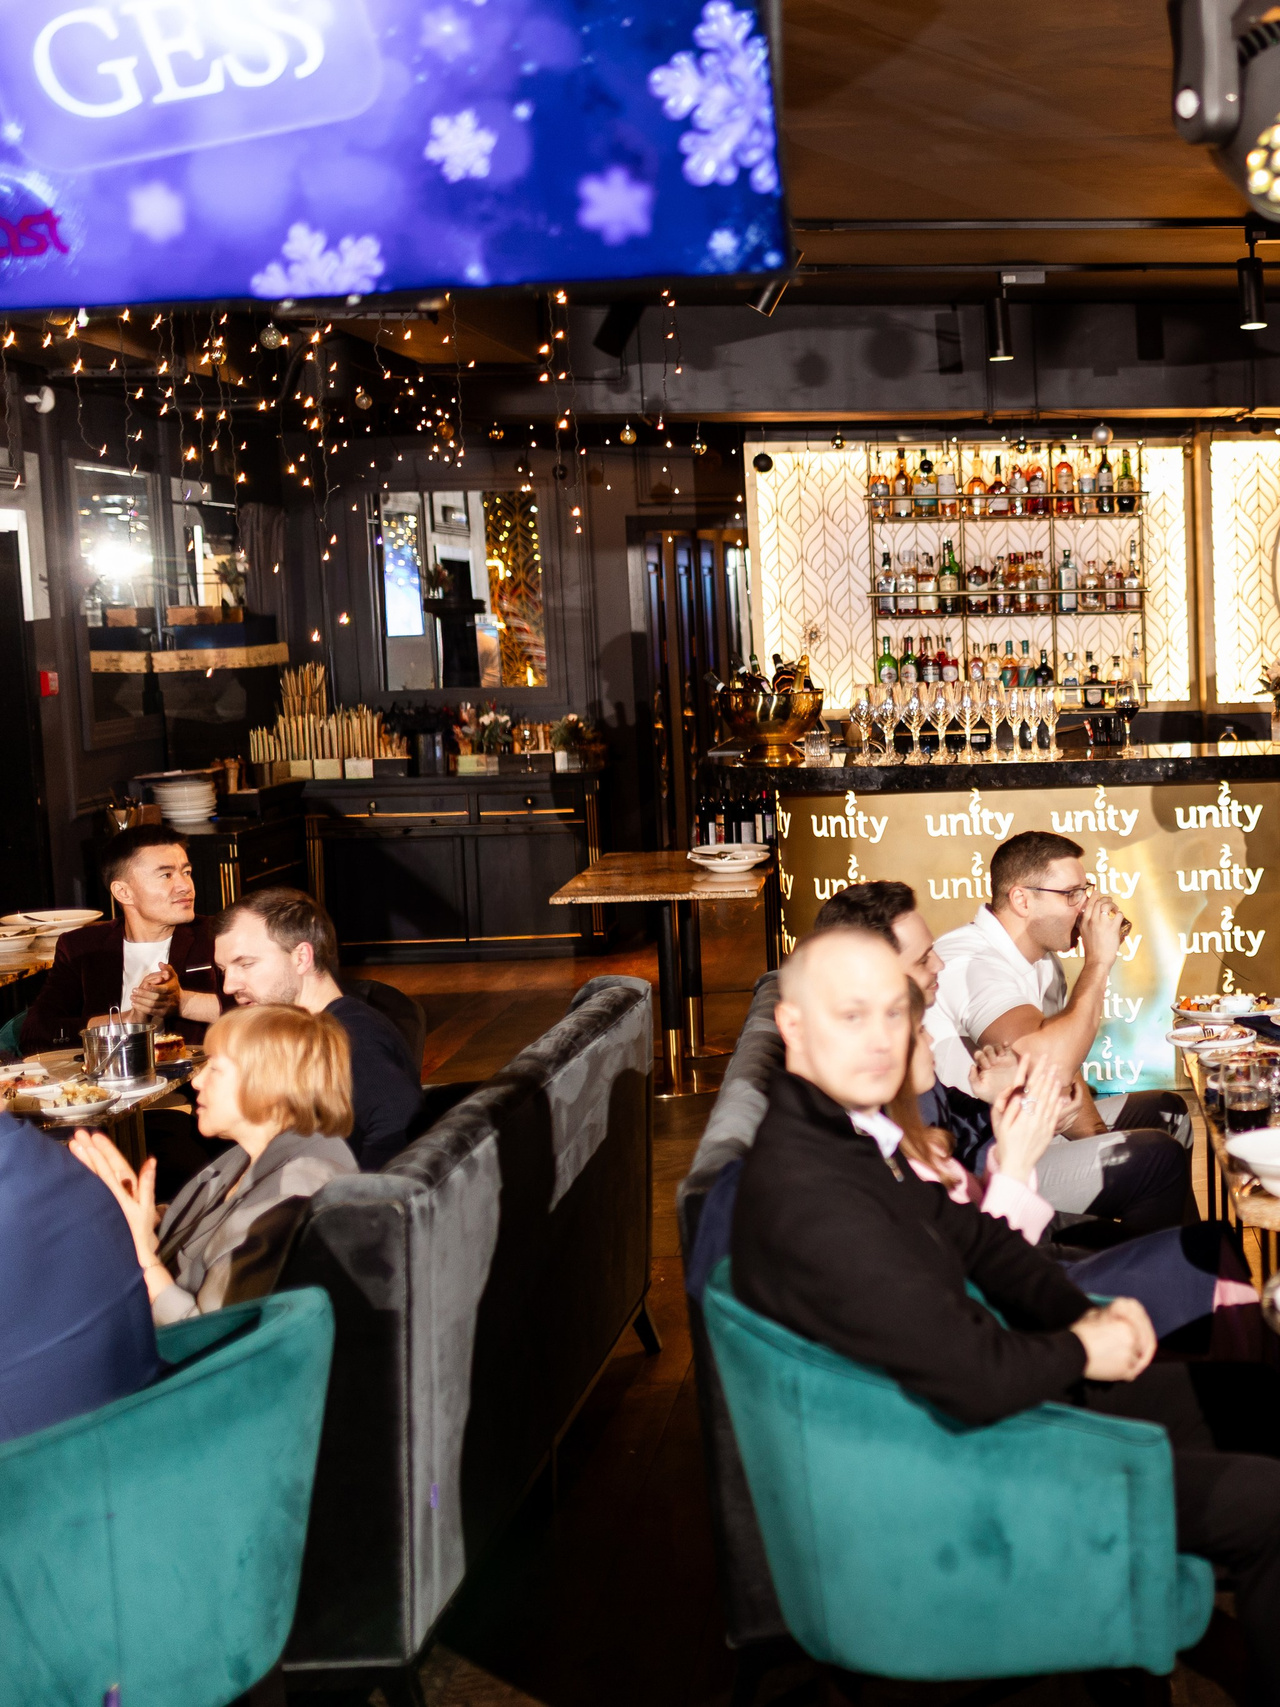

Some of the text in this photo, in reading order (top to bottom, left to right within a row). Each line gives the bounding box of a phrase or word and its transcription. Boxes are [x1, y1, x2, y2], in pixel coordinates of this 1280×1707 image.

[811, 790, 889, 844] unity
[925, 787, 1015, 841] unity
[1050, 784, 1140, 837] unity
[1174, 780, 1264, 833] unity
[927, 851, 993, 900] unit
[1176, 843, 1265, 895] unity
[1178, 905, 1266, 957] unity
[1083, 1036, 1145, 1085] nity
